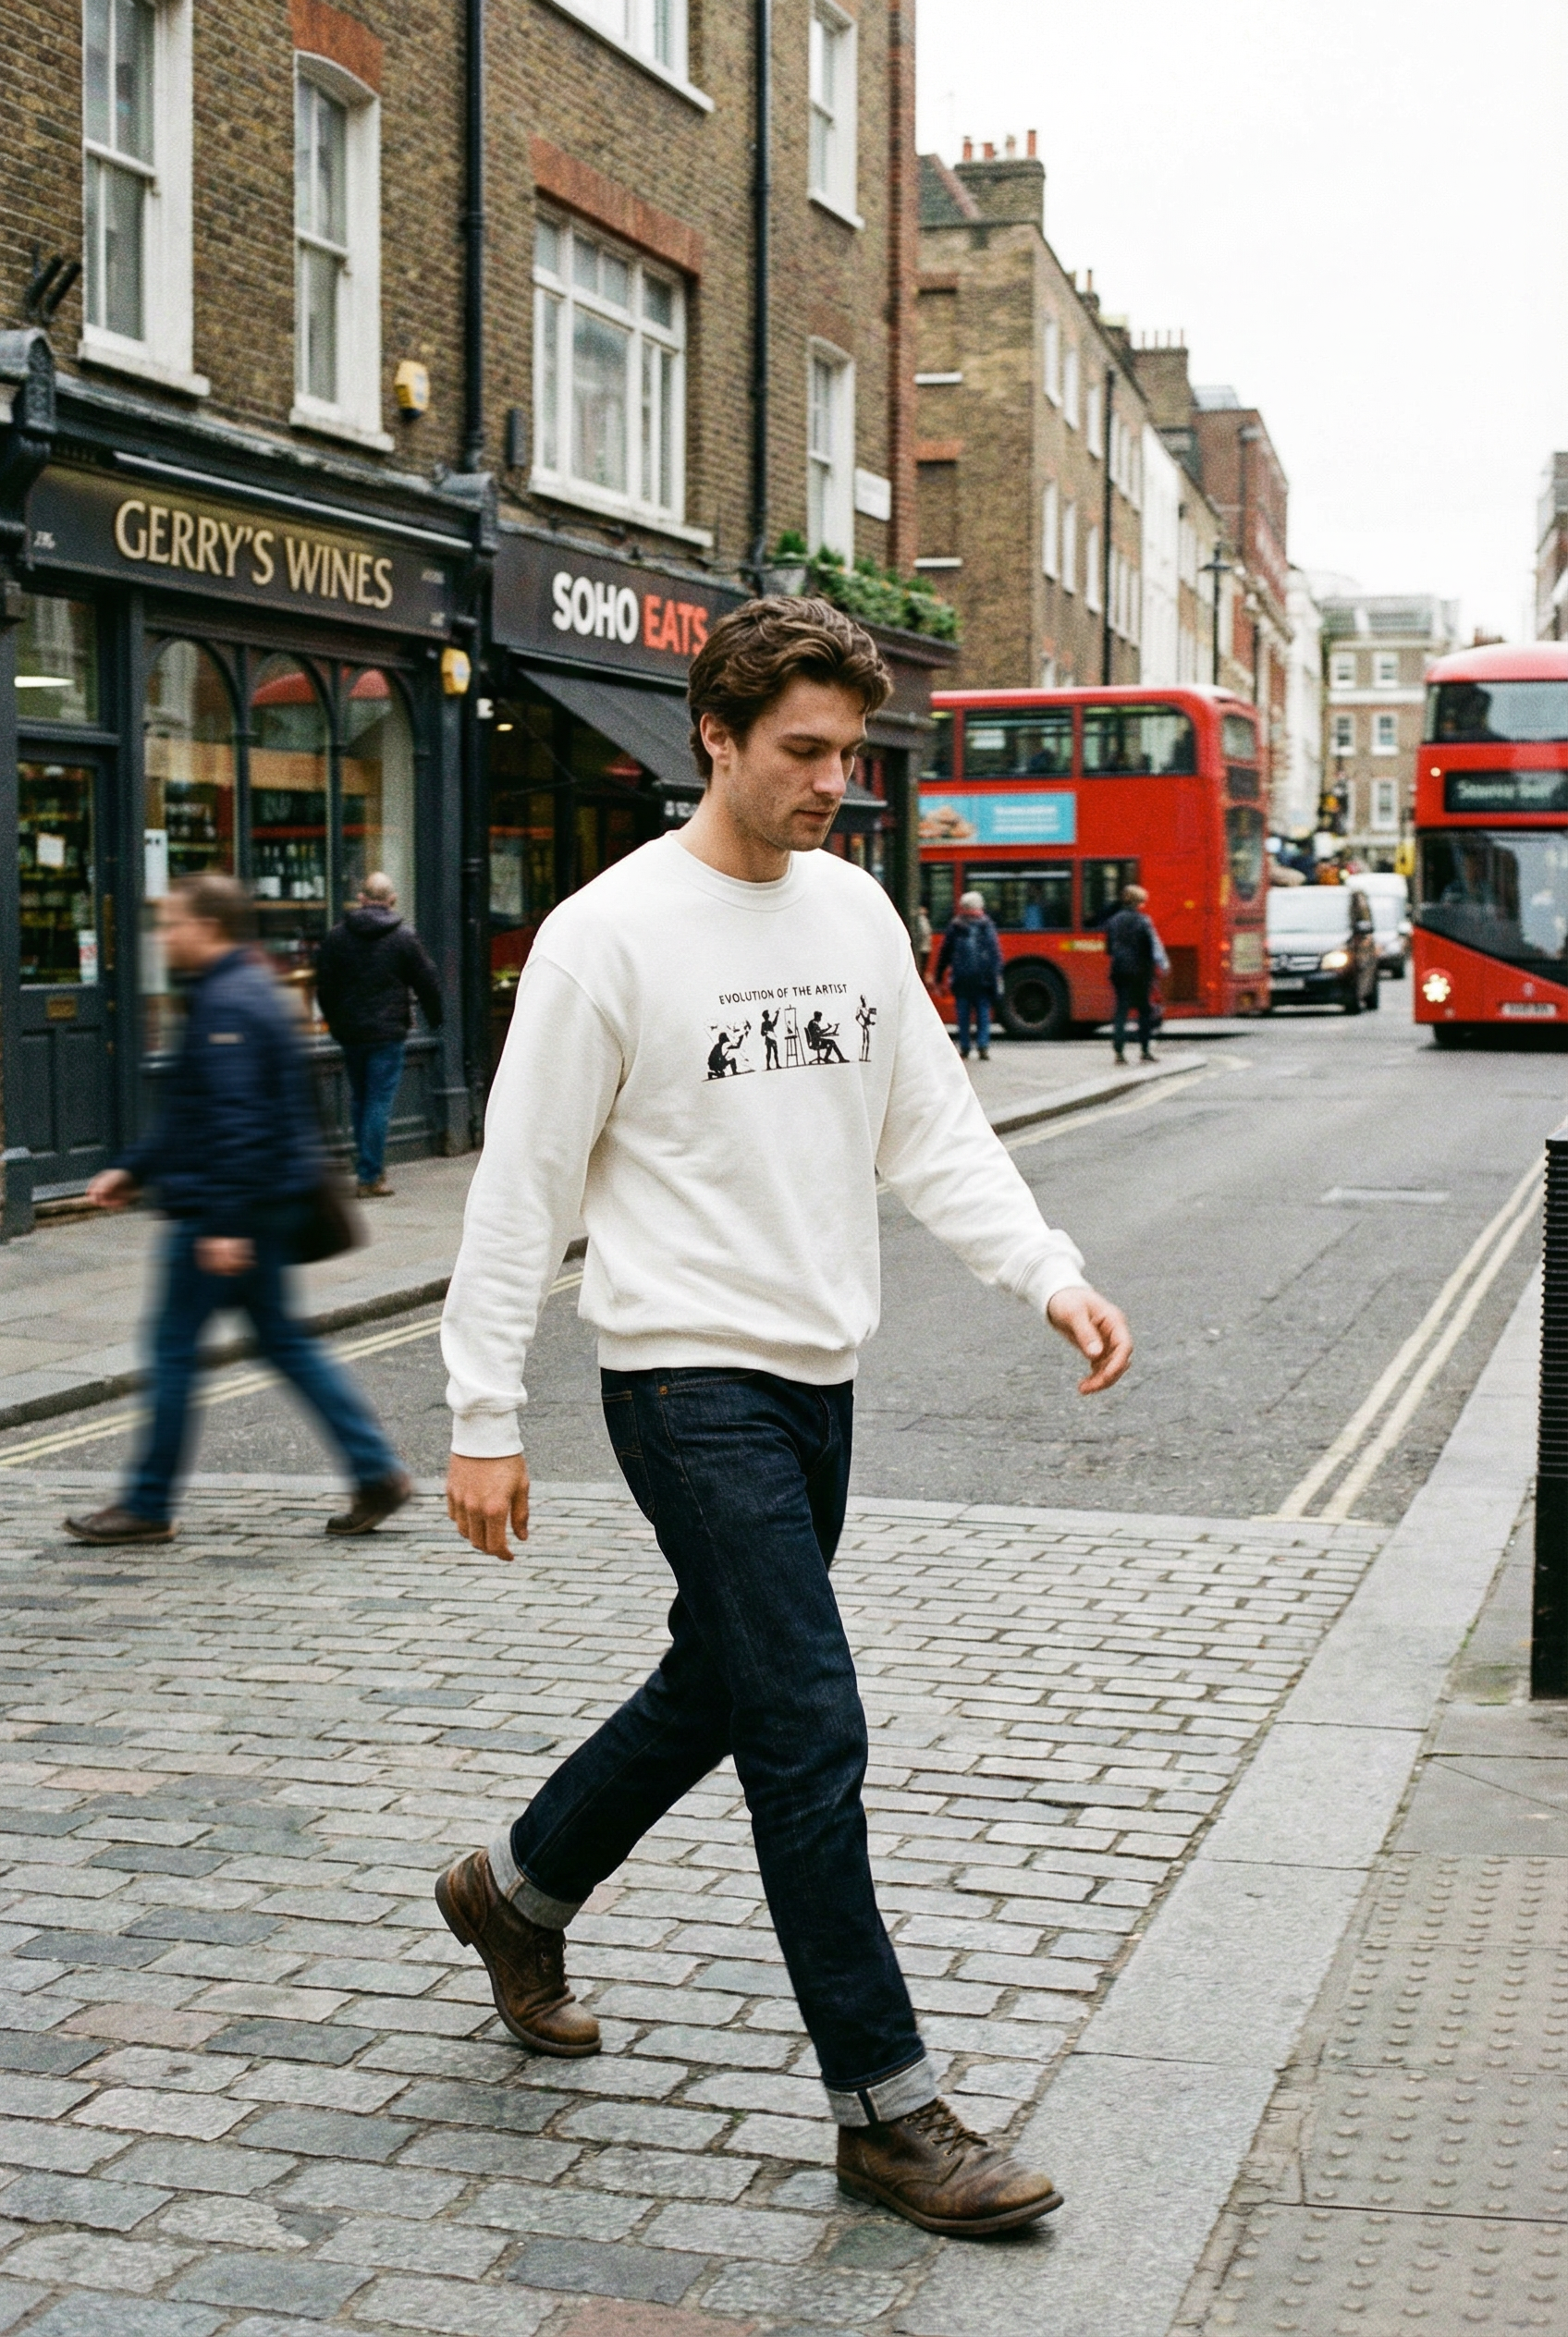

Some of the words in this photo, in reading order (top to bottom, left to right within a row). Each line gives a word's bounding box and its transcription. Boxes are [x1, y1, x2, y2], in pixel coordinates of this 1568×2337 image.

[115, 500, 275, 586] GERRY'S
[286, 536, 394, 610] WINES
[552, 570, 640, 644] SOHO
[643, 593, 709, 655] EATS
[719, 989, 774, 1005] EVOLUTION
[777, 987, 789, 997] OF
[792, 985, 812, 997] THE
[815, 984, 847, 995] ARTIST
